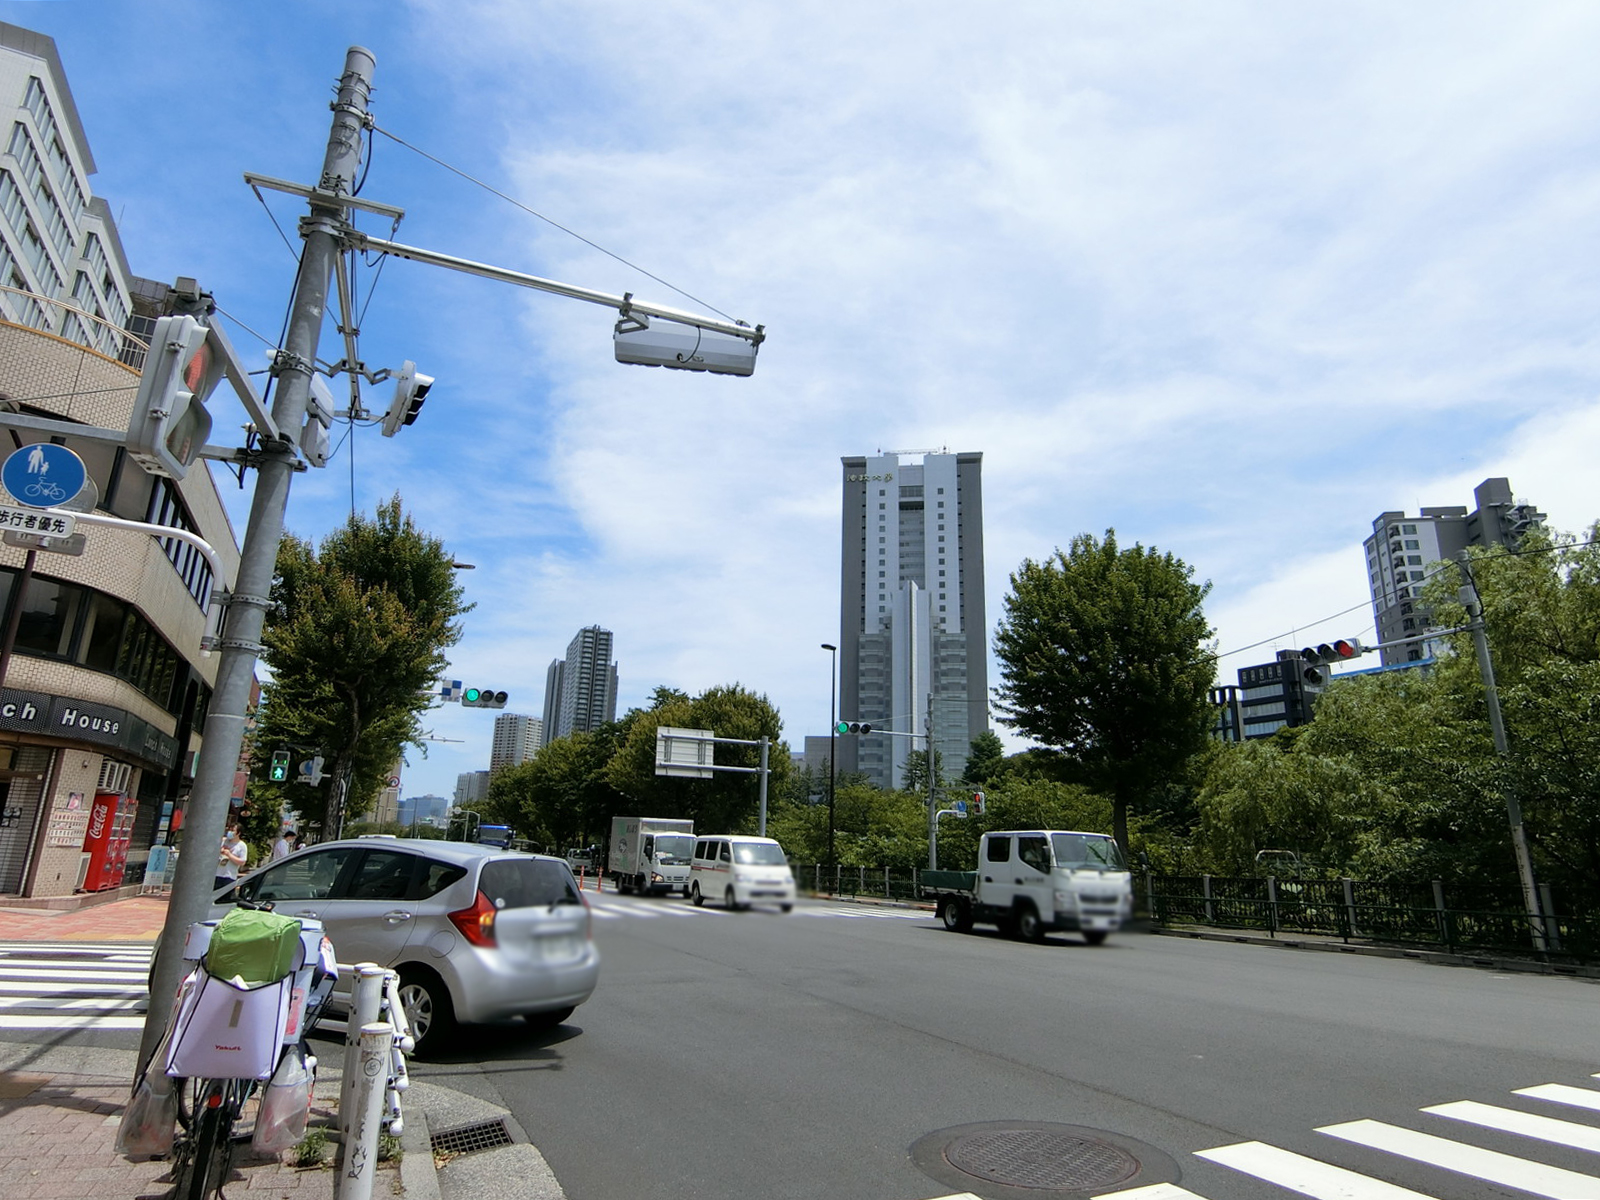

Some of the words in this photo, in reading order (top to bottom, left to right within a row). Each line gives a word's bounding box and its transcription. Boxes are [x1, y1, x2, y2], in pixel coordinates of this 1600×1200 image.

[0, 510, 66, 534] 歩行者優先
[61, 708, 120, 734] House
